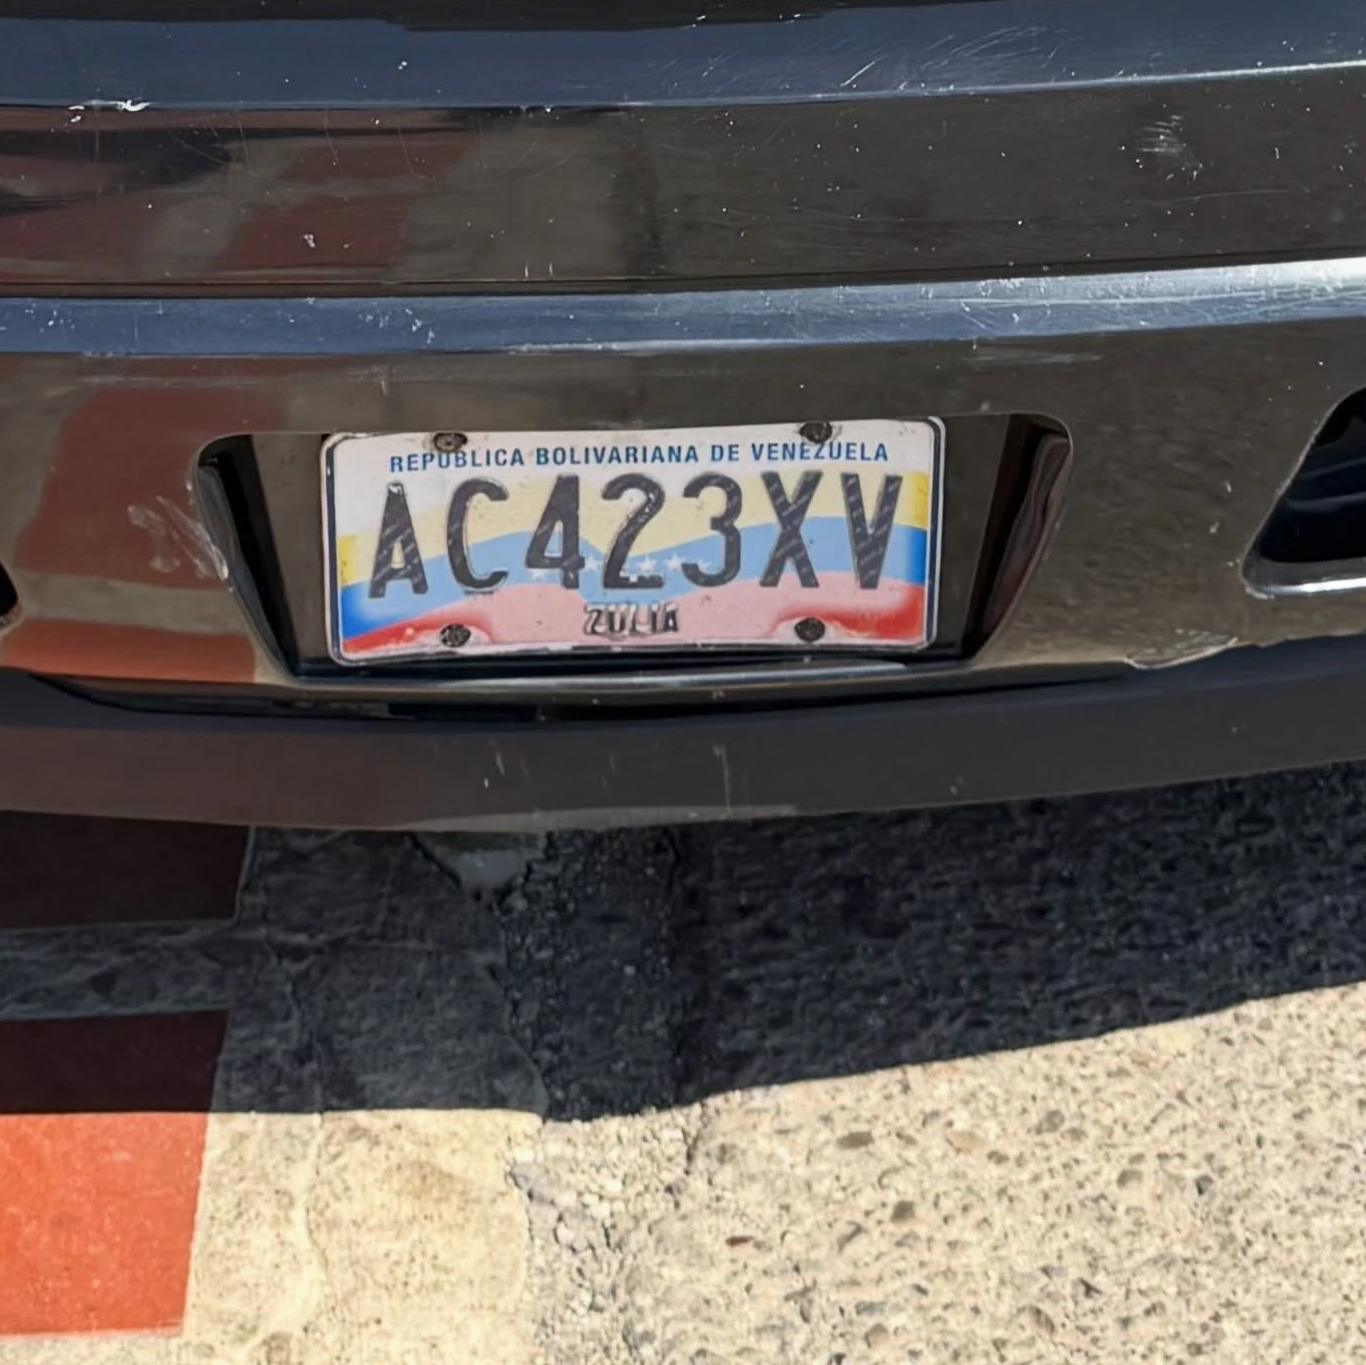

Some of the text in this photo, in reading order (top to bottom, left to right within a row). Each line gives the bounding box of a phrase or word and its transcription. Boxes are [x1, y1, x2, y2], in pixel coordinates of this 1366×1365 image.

[389, 441, 889, 473] REPUBLICA BOLIVARIANA DE VENEZUELA
[367, 471, 904, 599] AC423XV
[583, 603, 680, 637] ZULIA
